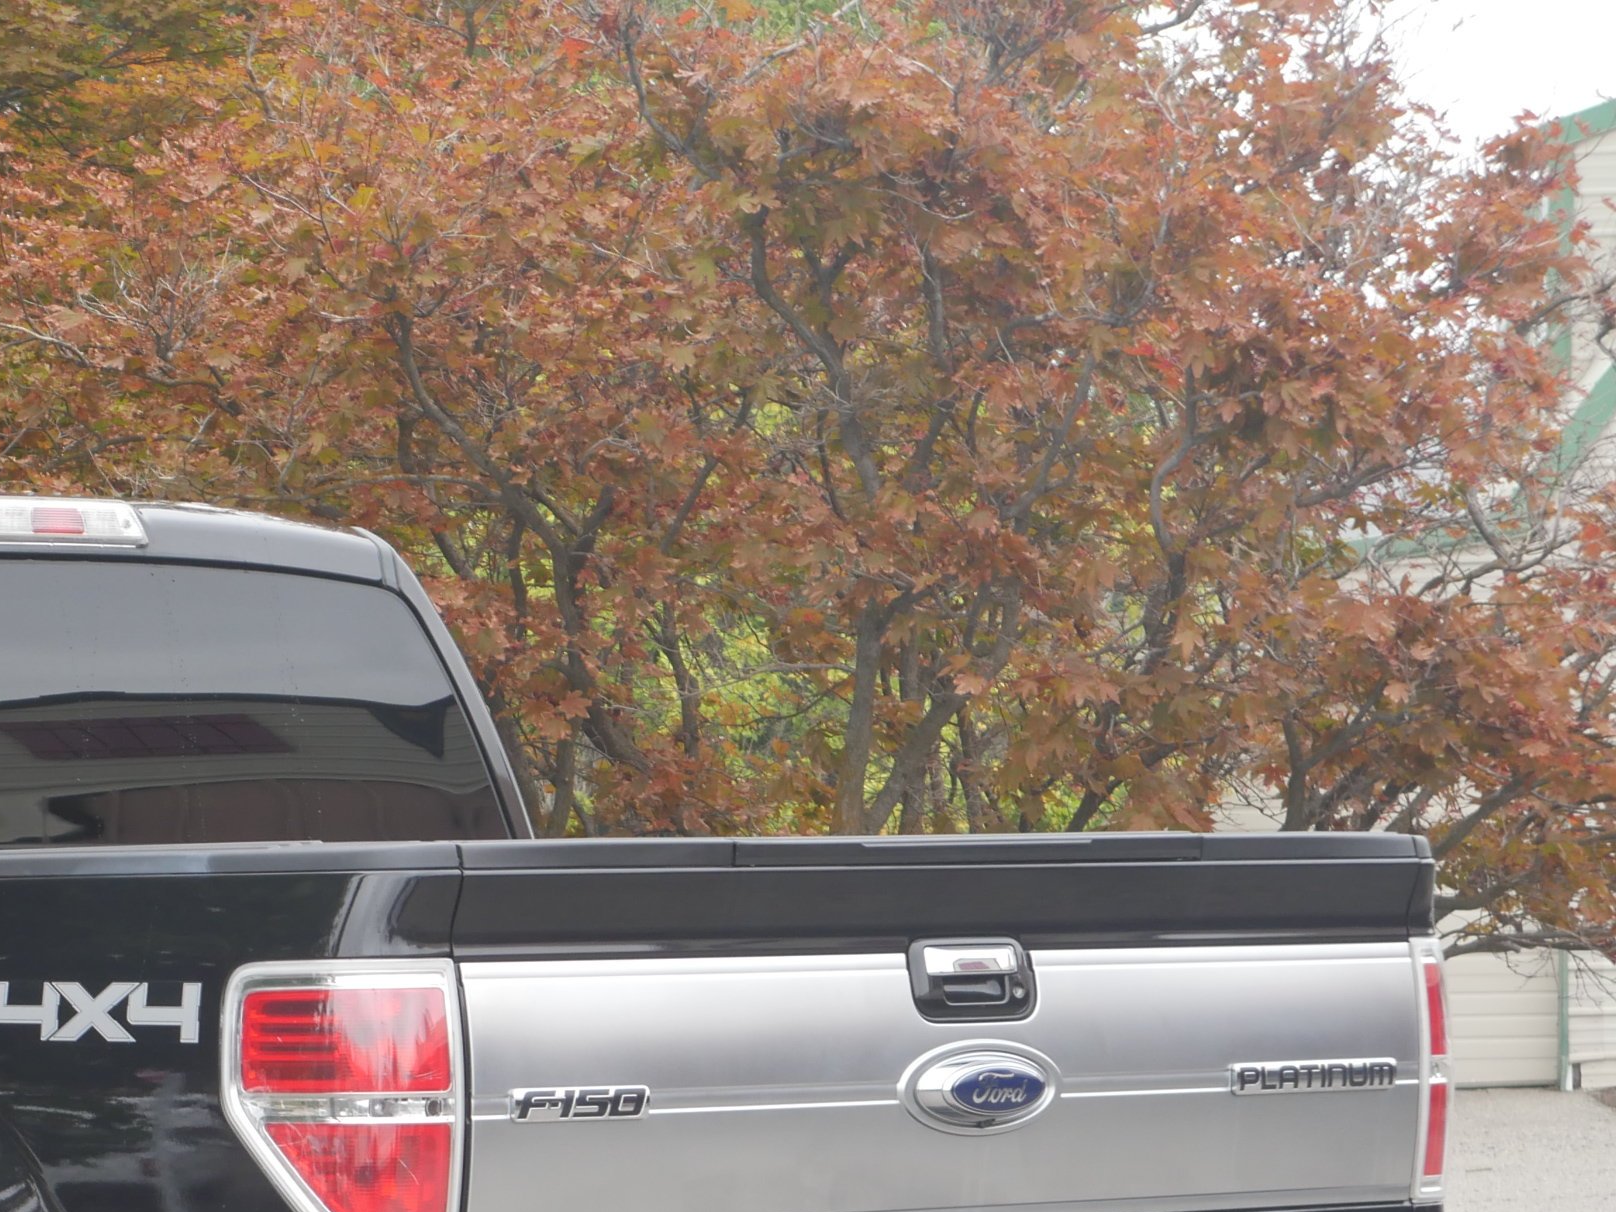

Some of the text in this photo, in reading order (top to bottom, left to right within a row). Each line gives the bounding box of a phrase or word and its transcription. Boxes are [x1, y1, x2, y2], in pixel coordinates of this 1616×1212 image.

[972, 1071, 1028, 1104] Ford
[1238, 1062, 1396, 1091] PLATINUM
[516, 1088, 646, 1120] F-150
